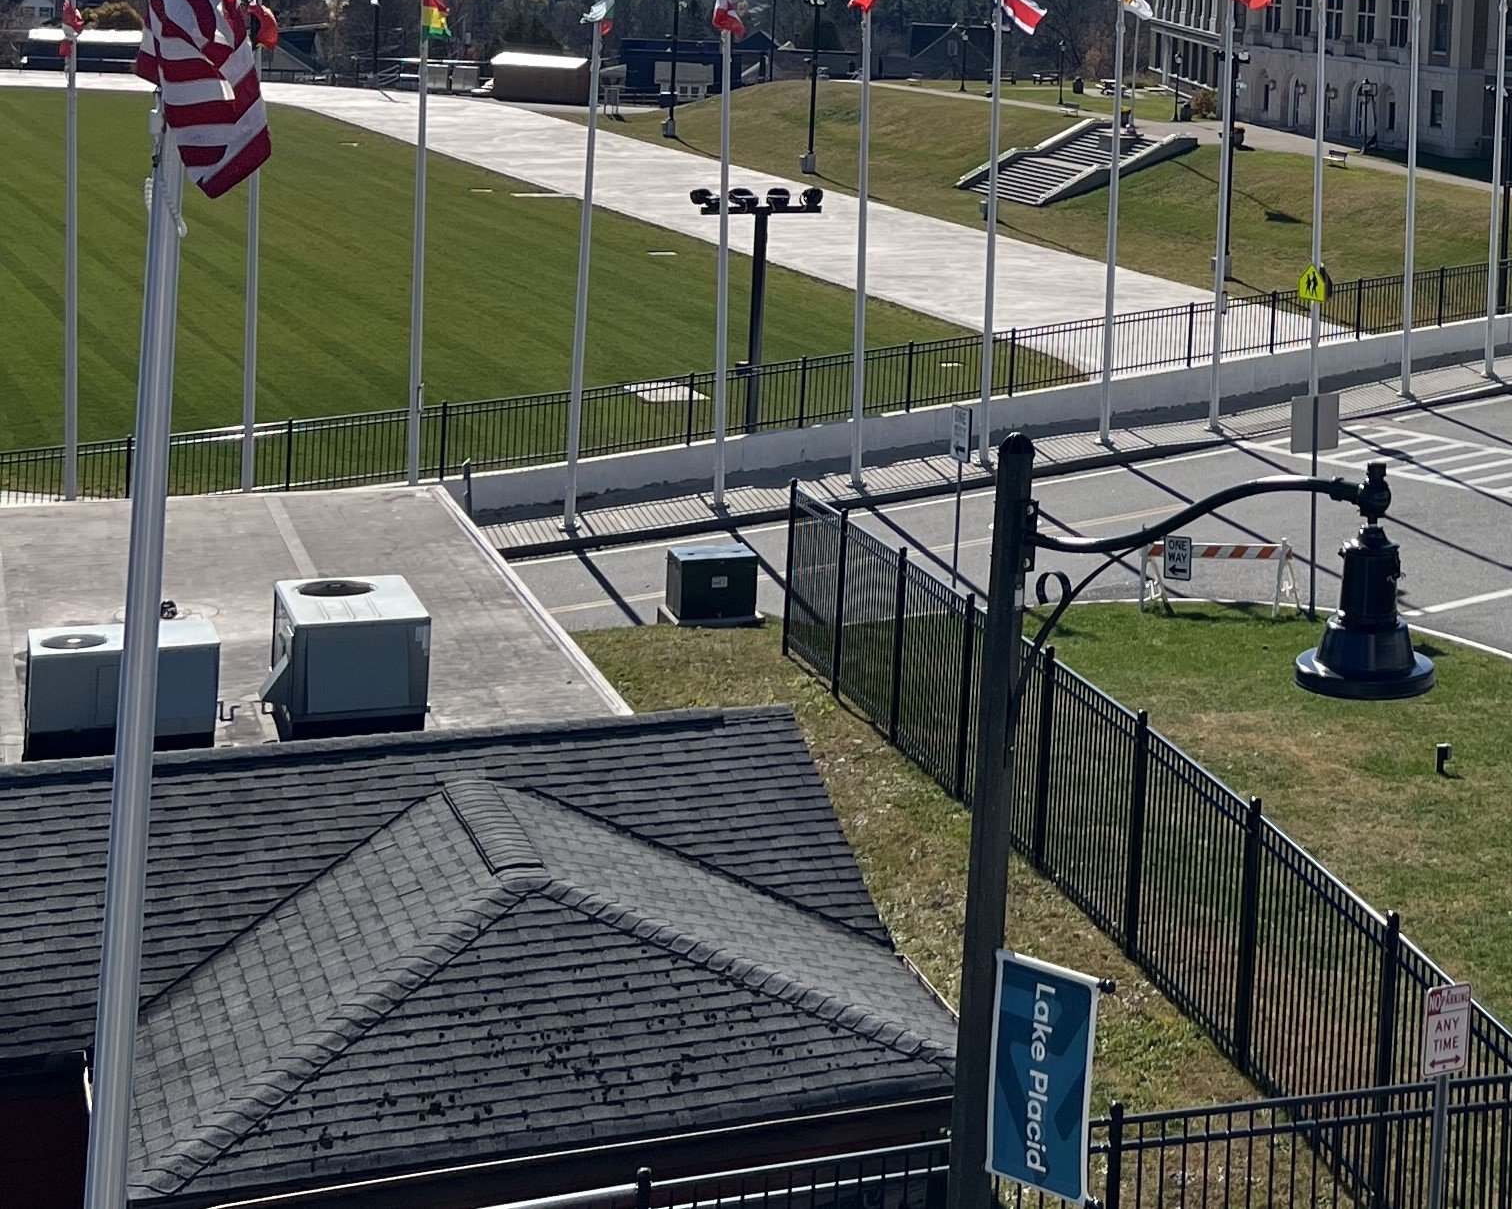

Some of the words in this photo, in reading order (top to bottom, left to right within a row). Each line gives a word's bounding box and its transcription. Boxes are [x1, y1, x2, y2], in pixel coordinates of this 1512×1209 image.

[1168, 540, 1187, 550] ONE
[1168, 552, 1187, 563] WAY
[1429, 993, 1440, 1011] NO
[1030, 982, 1056, 1062] Lake
[1435, 1017, 1459, 1032] ANY
[1434, 1036, 1459, 1052] TIME
[1027, 1069, 1049, 1173] Placid
